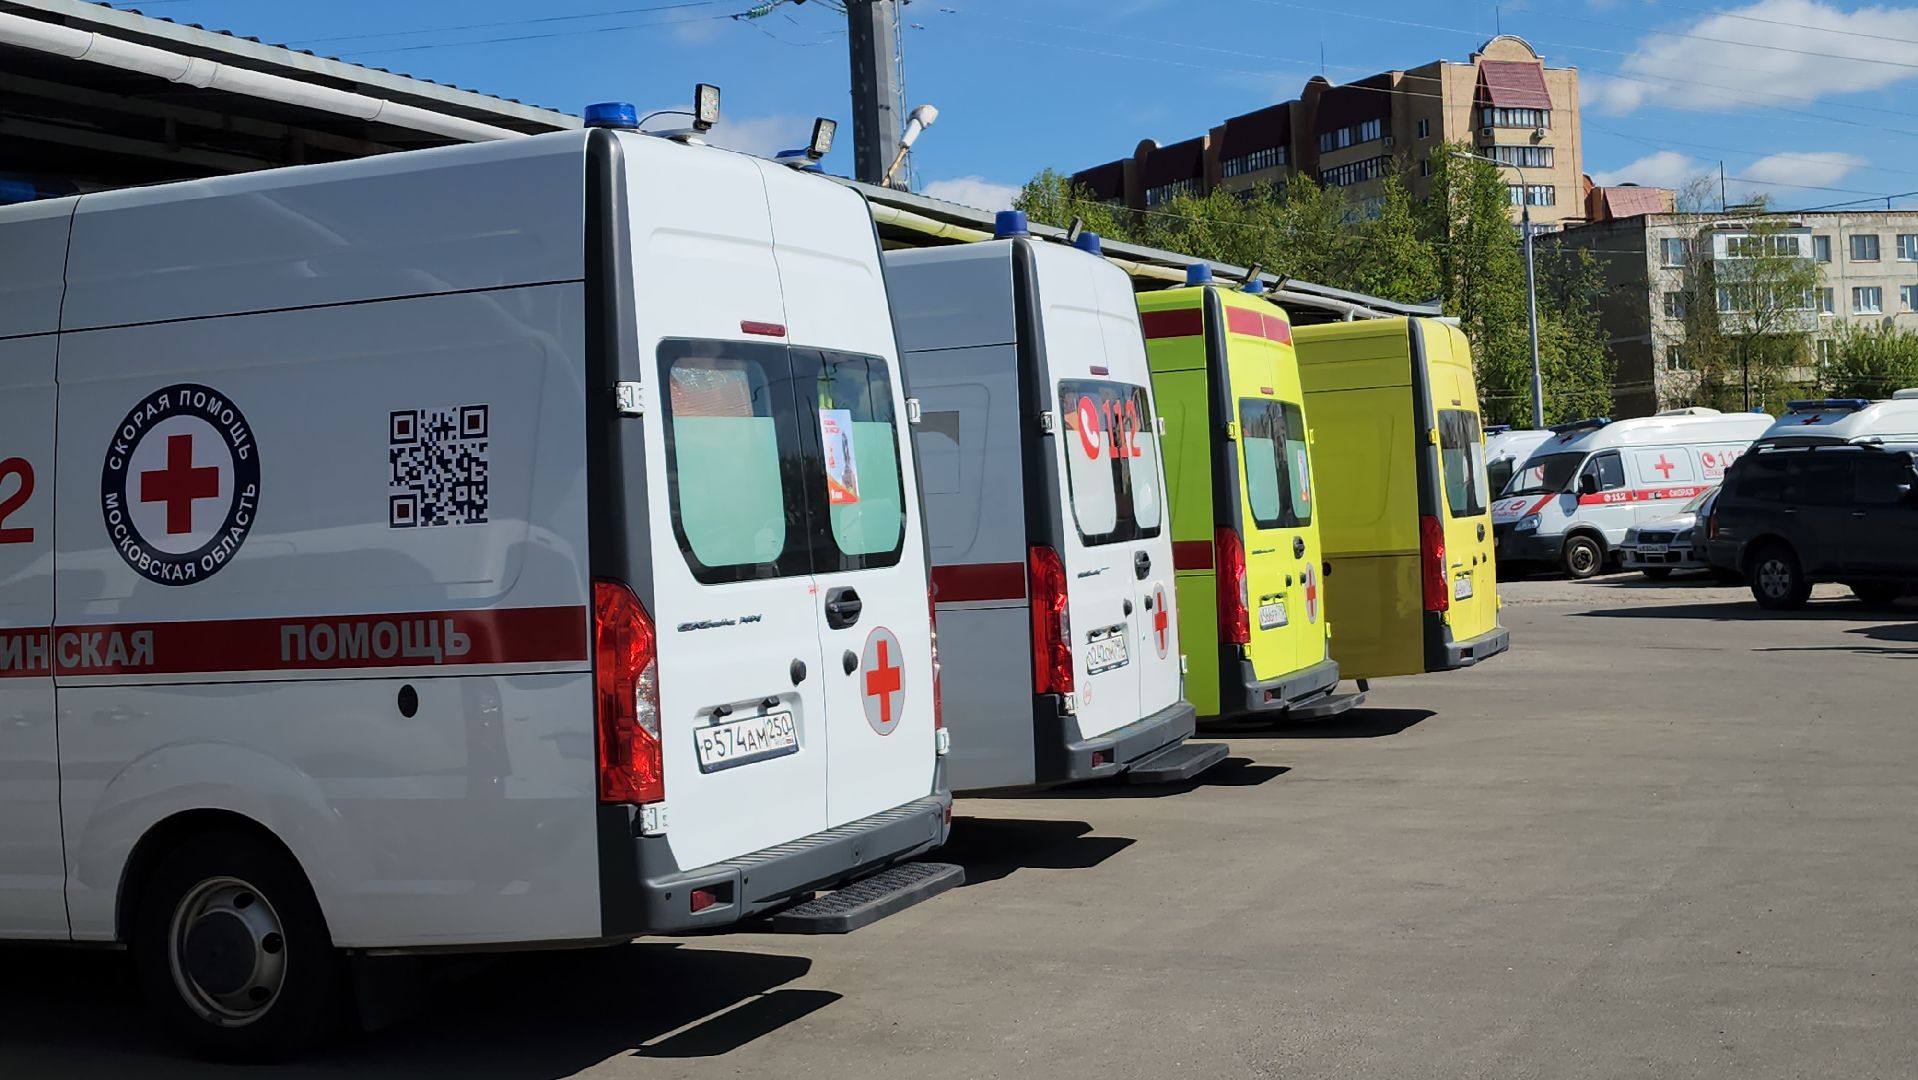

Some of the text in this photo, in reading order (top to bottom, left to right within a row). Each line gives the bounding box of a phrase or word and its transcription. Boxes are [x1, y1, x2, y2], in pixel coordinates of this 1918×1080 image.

[109, 390, 251, 470] СКОРАЯ ПОМОЩЬ
[1102, 399, 1141, 458] 112
[1612, 492, 1626, 502] 112
[105, 483, 256, 580] МОСКОВСКАЯ ОБЛАСТЬ
[280, 618, 472, 664] ПОМОЩЬ
